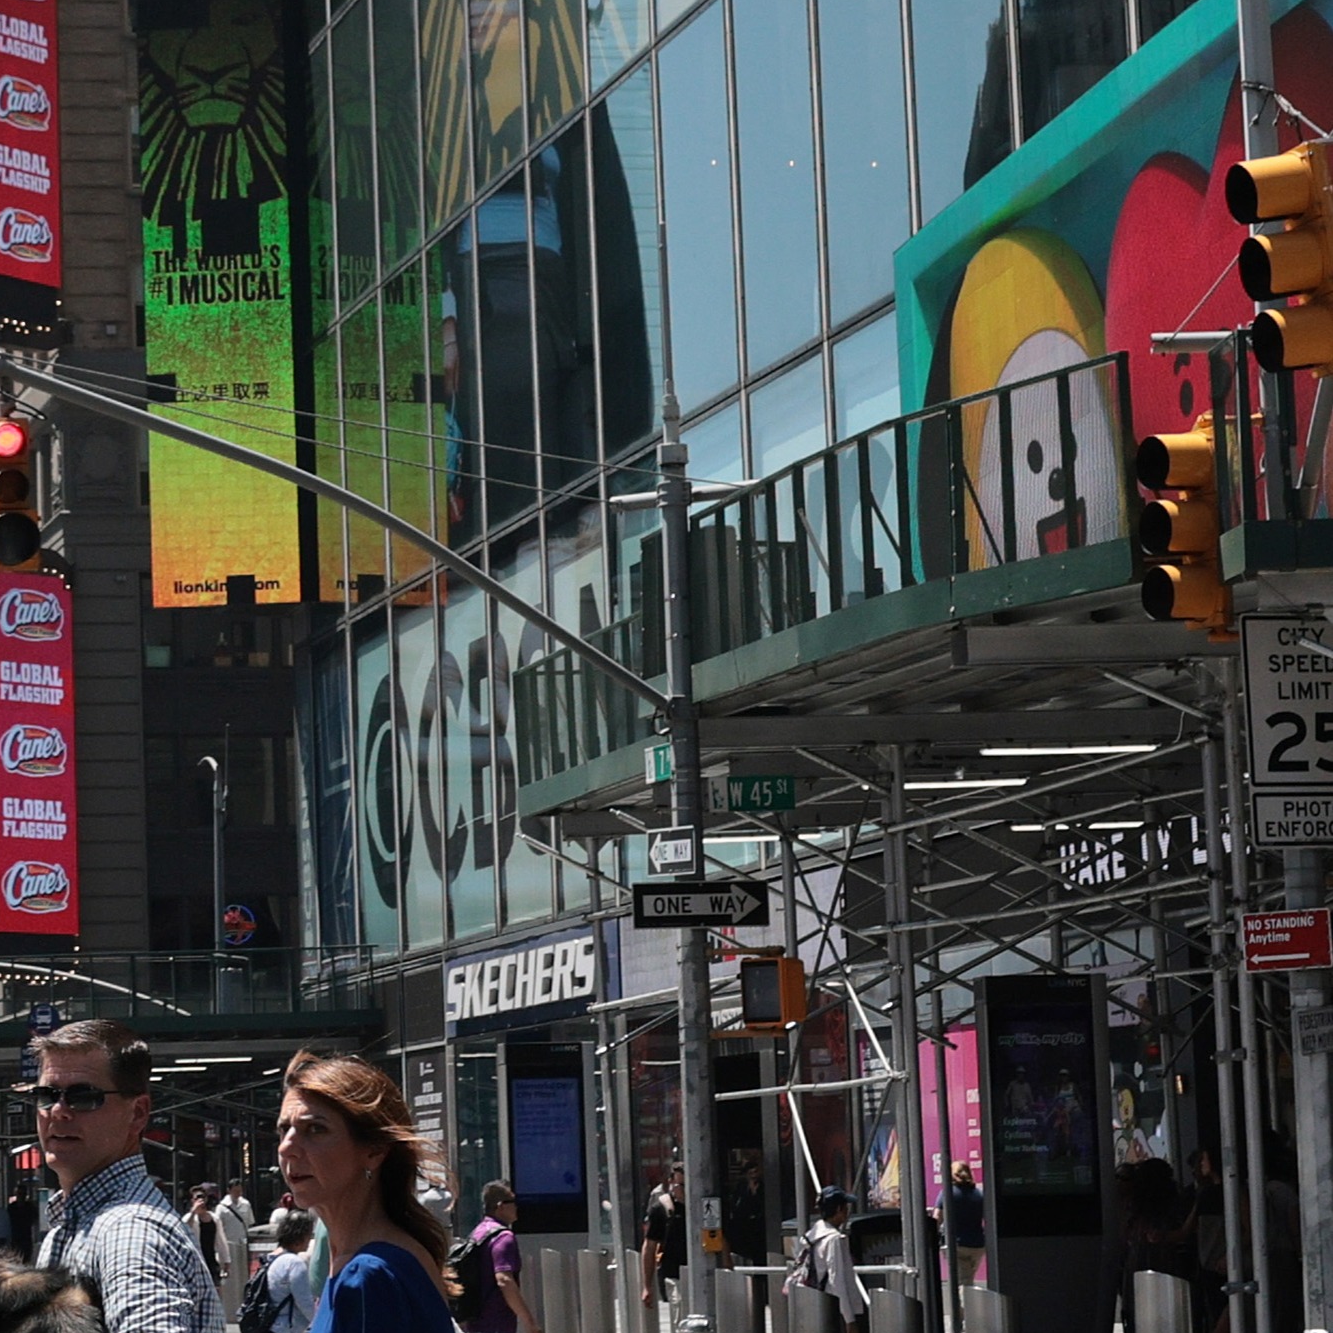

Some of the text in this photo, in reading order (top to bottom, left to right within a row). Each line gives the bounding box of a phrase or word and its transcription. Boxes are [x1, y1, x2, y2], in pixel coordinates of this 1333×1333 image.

[152, 244, 282, 274] THE WORLD'S
[148, 270, 286, 306] #1 MUSICAL
[173, 577, 280, 595] lionkinom
[0, 587, 63, 634] Cane's
[1276, 626, 1326, 647] CITY
[0, 660, 64, 688] GLOBAL
[0, 682, 65, 706] FLAGSHIP
[1277, 681, 1333, 701] LIMIT
[2, 723, 66, 771] Cane's
[729, 778, 789, 807] W 45 St
[2, 797, 67, 823] GLOBAL
[1283, 800, 1333, 817] PHOT
[2, 819, 67, 841] FLAGSHIP
[654, 842, 689, 862] ONE WAY
[5, 860, 69, 907] Cane's
[653, 894, 749, 915] ONE WAY
[1247, 915, 1315, 932] NO STANDING
[1248, 932, 1291, 946] Anytime
[445, 935, 595, 1023] SKECHERS
